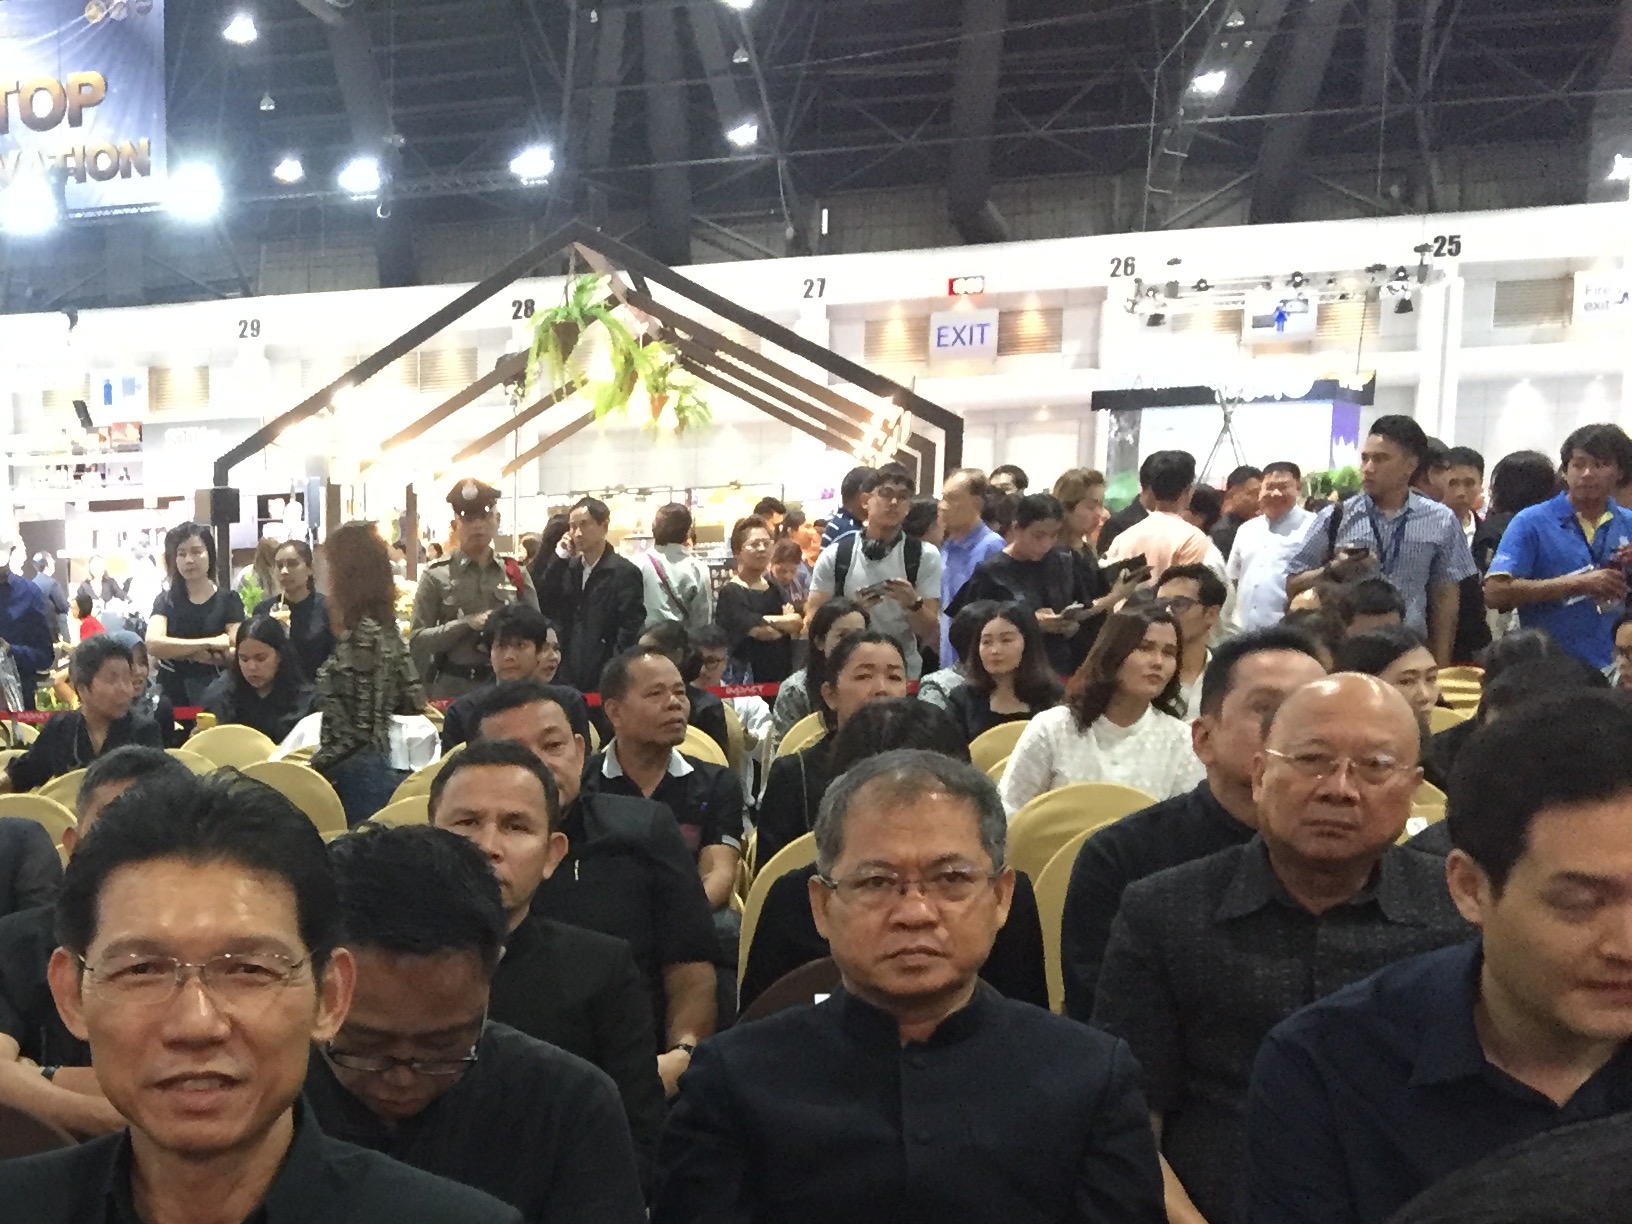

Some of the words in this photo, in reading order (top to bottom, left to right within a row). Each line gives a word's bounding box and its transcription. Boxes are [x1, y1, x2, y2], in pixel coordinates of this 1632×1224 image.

[1432, 234, 1462, 257] 25
[1110, 256, 1136, 278] 26
[803, 277, 827, 299] 27
[512, 299, 536, 320] 28
[237, 319, 262, 339] 29
[936, 322, 991, 348] EXIT
